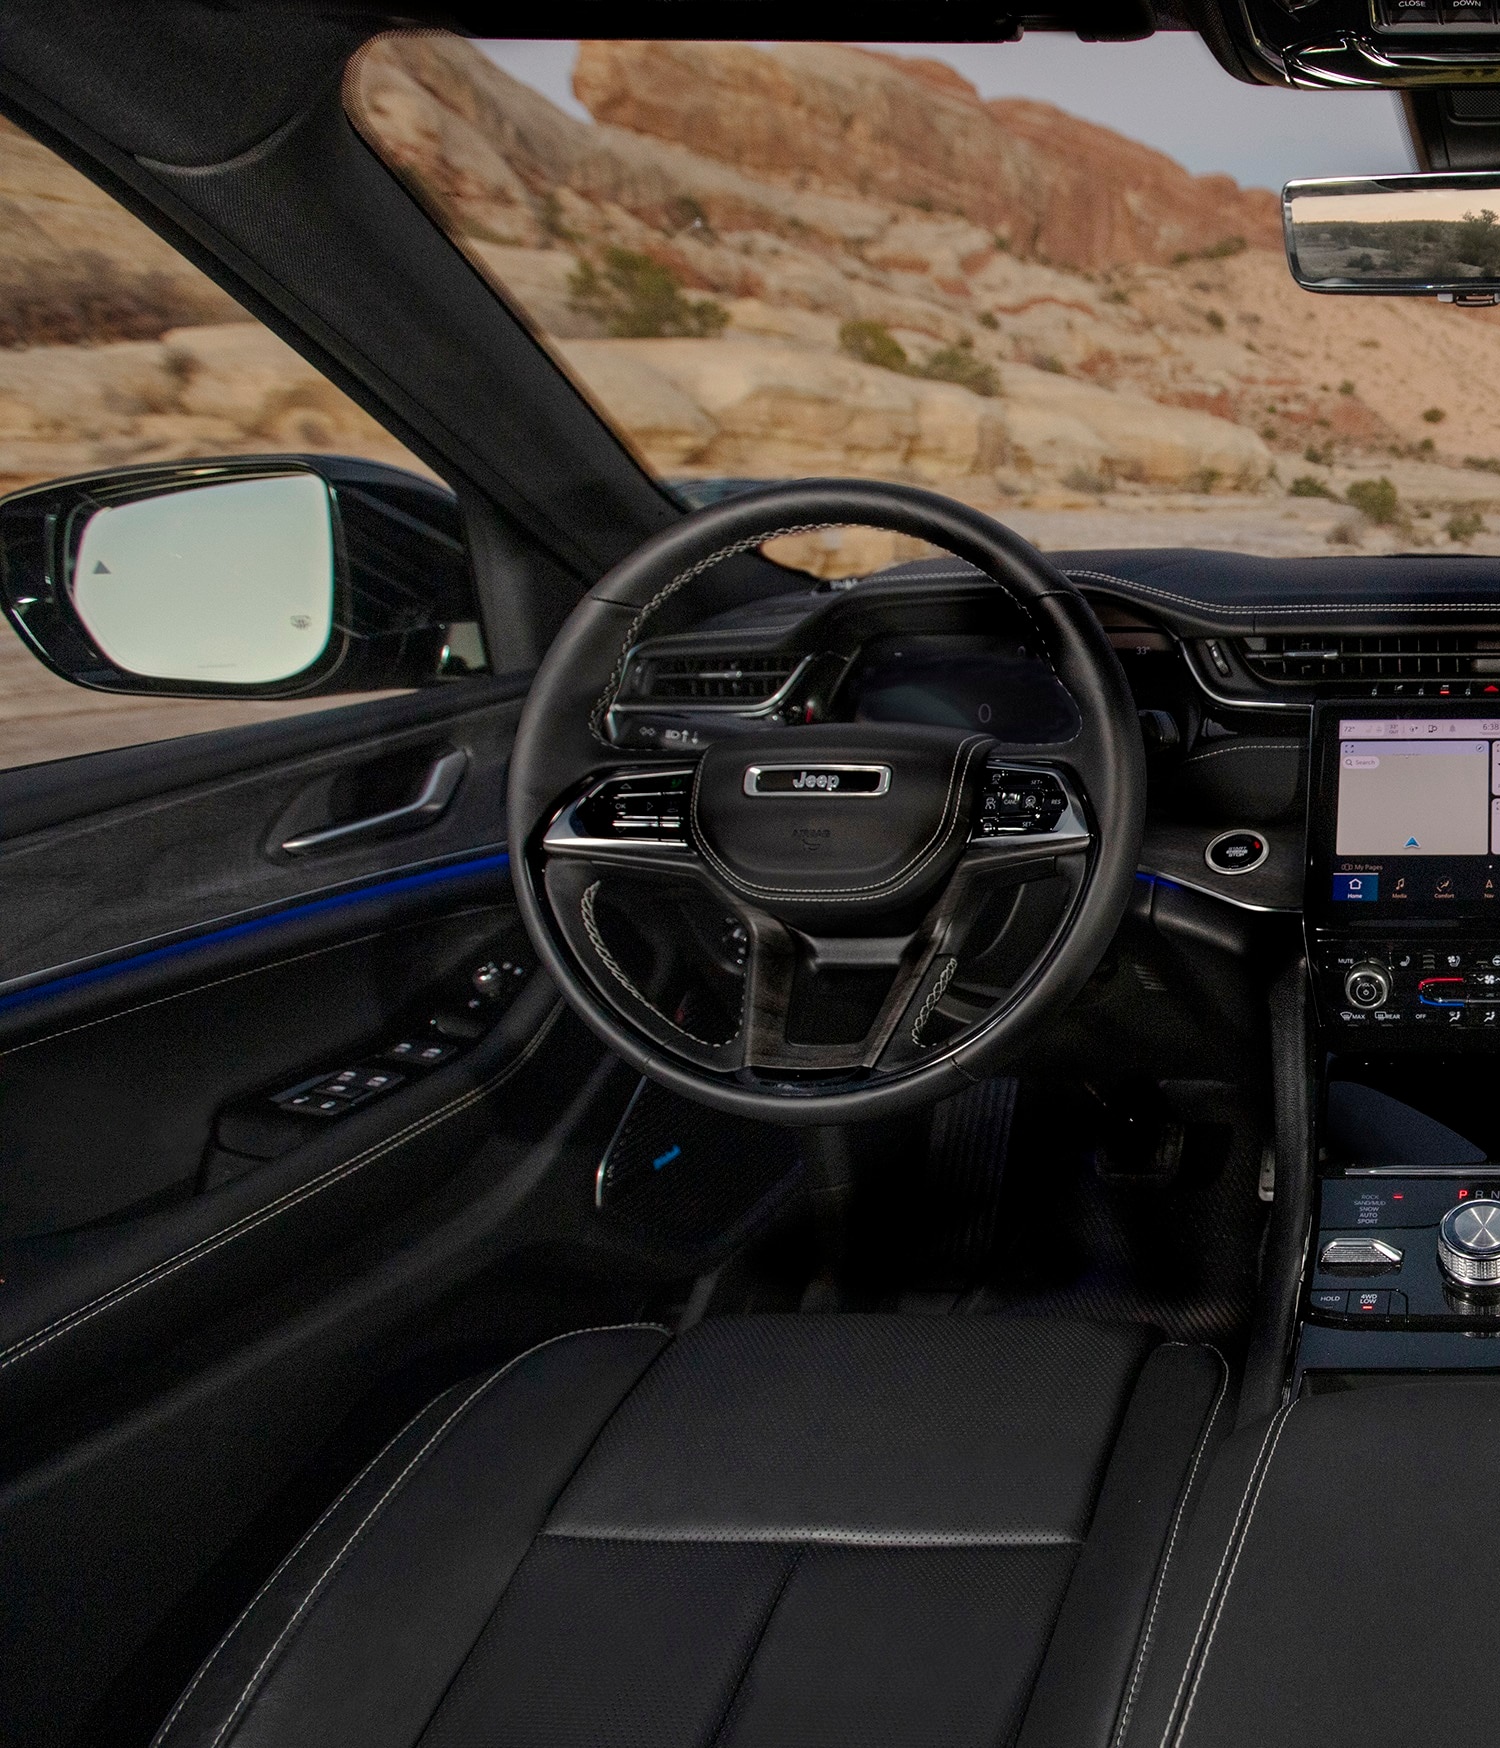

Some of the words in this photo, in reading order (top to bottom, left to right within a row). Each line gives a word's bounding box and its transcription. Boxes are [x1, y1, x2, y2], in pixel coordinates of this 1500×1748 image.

[1398, 0, 1426, 8] CLOSE
[978, 703, 992, 723] 0
[1482, 723, 1500, 731] 6:38
[792, 771, 840, 791] Jeep
[1458, 1190, 1468, 1199] P
[1474, 1190, 1484, 1199] R
[1490, 1190, 1500, 1199] N
